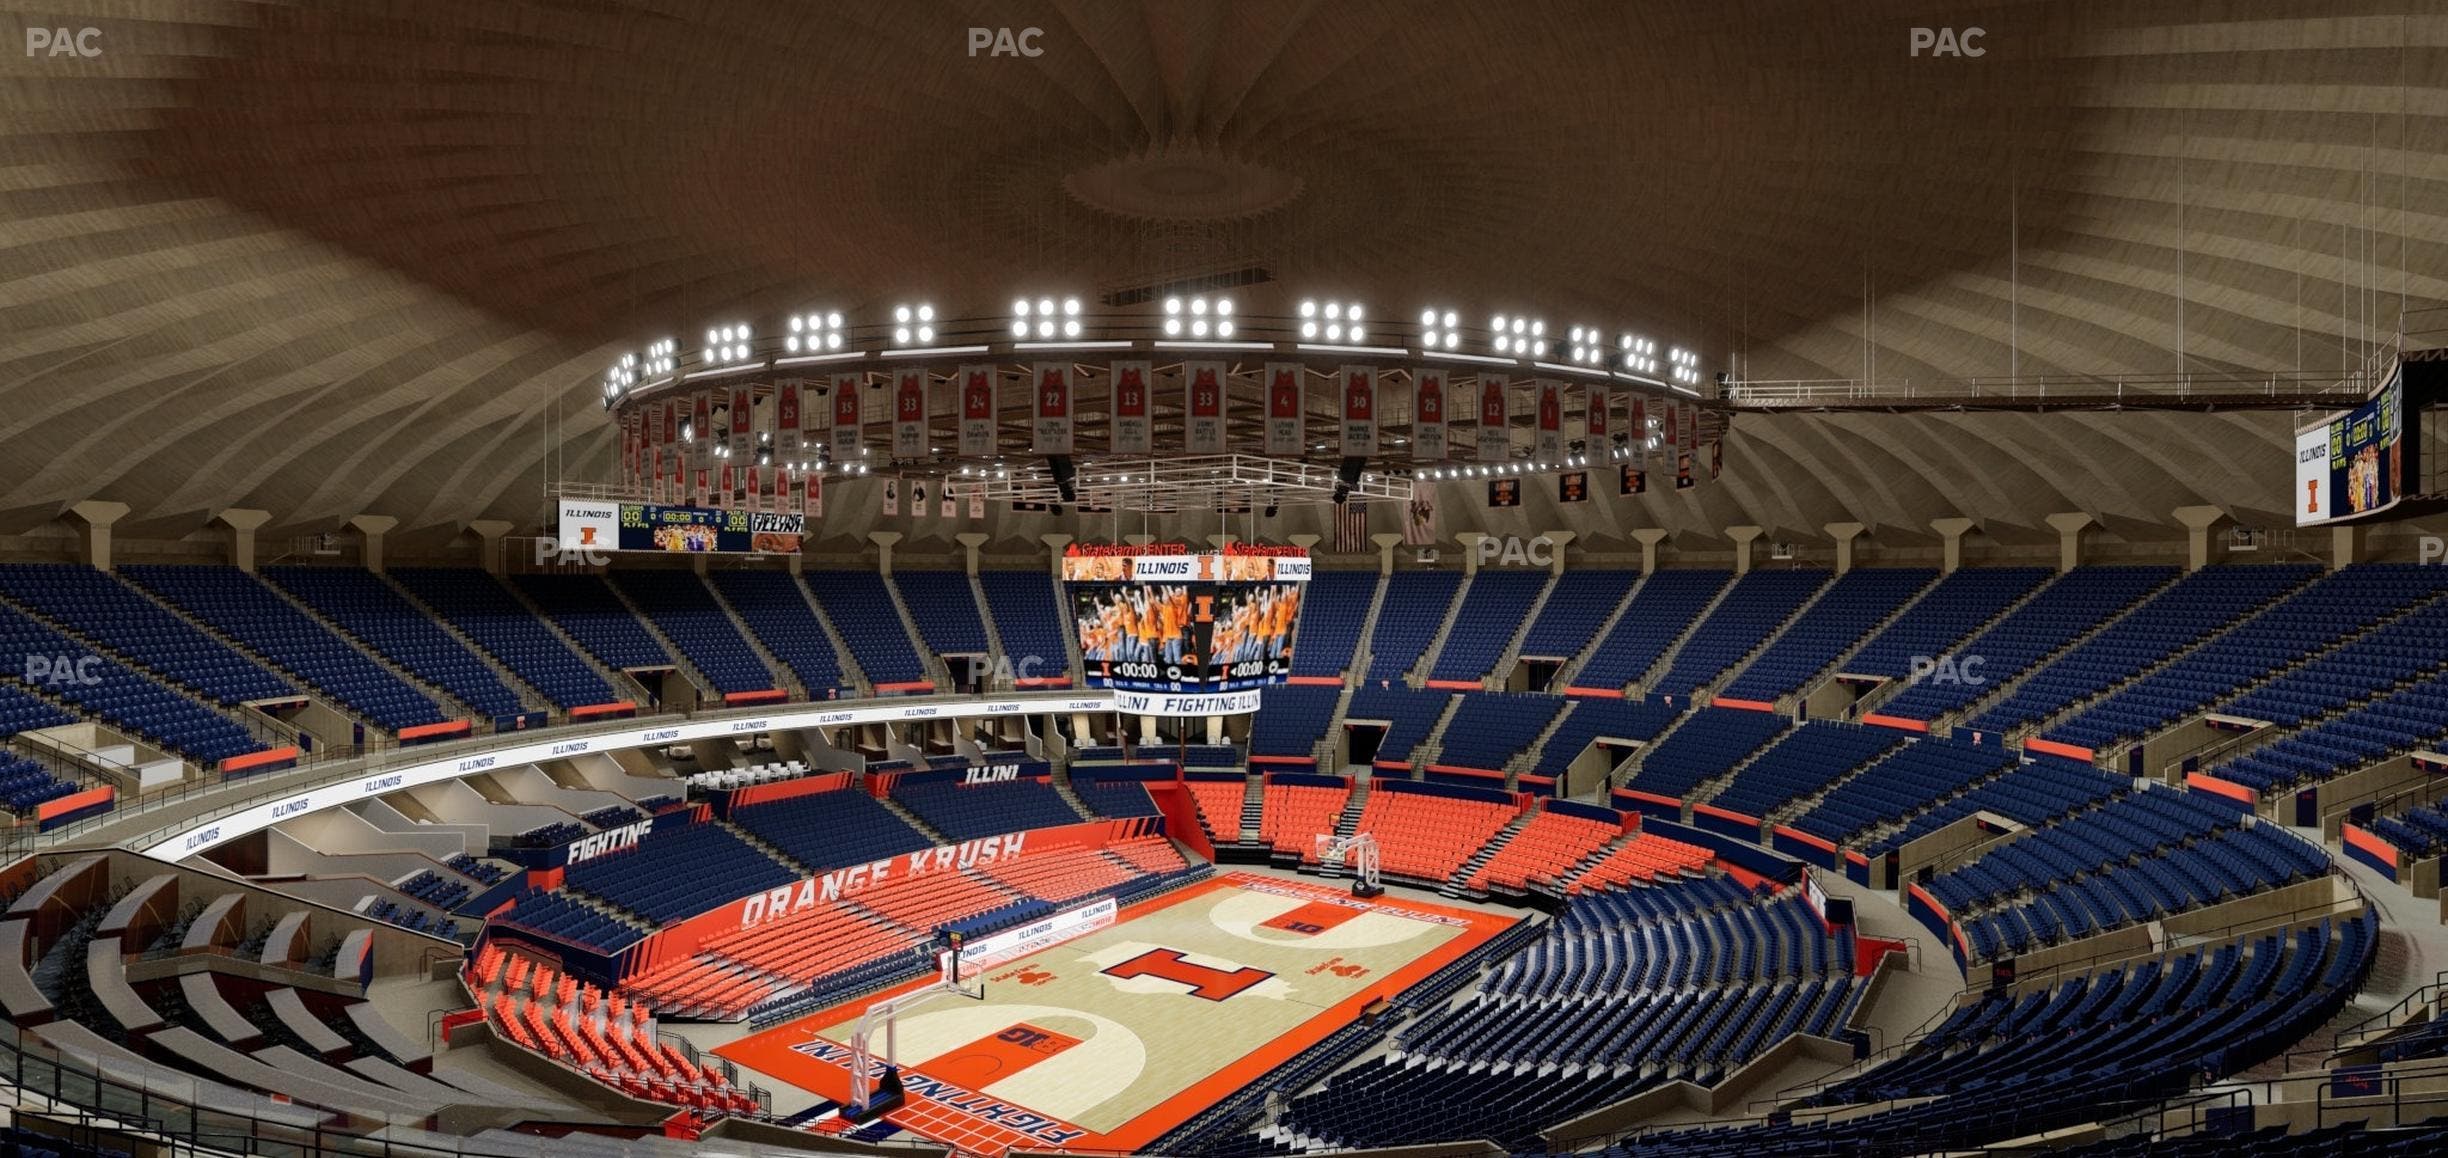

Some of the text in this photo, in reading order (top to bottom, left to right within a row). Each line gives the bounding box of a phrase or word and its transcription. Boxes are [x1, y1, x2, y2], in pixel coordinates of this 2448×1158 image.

[903, 398, 917, 412] 33
[1124, 392, 1138, 406] 13
[2299, 443, 2326, 464] ILLINOIS
[2308, 479, 2318, 513] I
[565, 509, 613, 519] ILLINOIS
[623, 511, 641, 523] 00
[580, 527, 597, 545] I
[1136, 556, 1311, 580] ILLINOIS I ILLINOIS
[1195, 596, 1214, 622] I
[1122, 662, 1158, 679] 00:00
[1237, 661, 1264, 677] 00:00
[905, 708, 937, 717] ILLINOIS
[987, 704, 1020, 712] ILLINOIS
[1068, 702, 1101, 710] ILLINOIS
[1164, 697, 1236, 712] FIGHTING
[732, 720, 767, 731] ILLINOIS
[820, 713, 853, 723] ILLINOIS
[643, 729, 679, 742] ILLINOIS
[552, 741, 588, 756] ILLINOIS
[458, 756, 496, 773] ILLINOIS
[965, 764, 1019, 784] ILLINI
[365, 775, 403, 793] ILLINOIS
[272, 798, 309, 819] ILLINOIS
[186, 827, 220, 851] ILLINOIS
[567, 818, 653, 865] FIGHTING
[741, 832, 1026, 930] ORANGE KRUSH
[1081, 902, 1113, 920] ILLINOIS
[1018, 922, 1053, 942] ILLINOIS
[1100, 948, 1275, 1001] I
[903, 1074, 1088, 1145] FIGHTING
